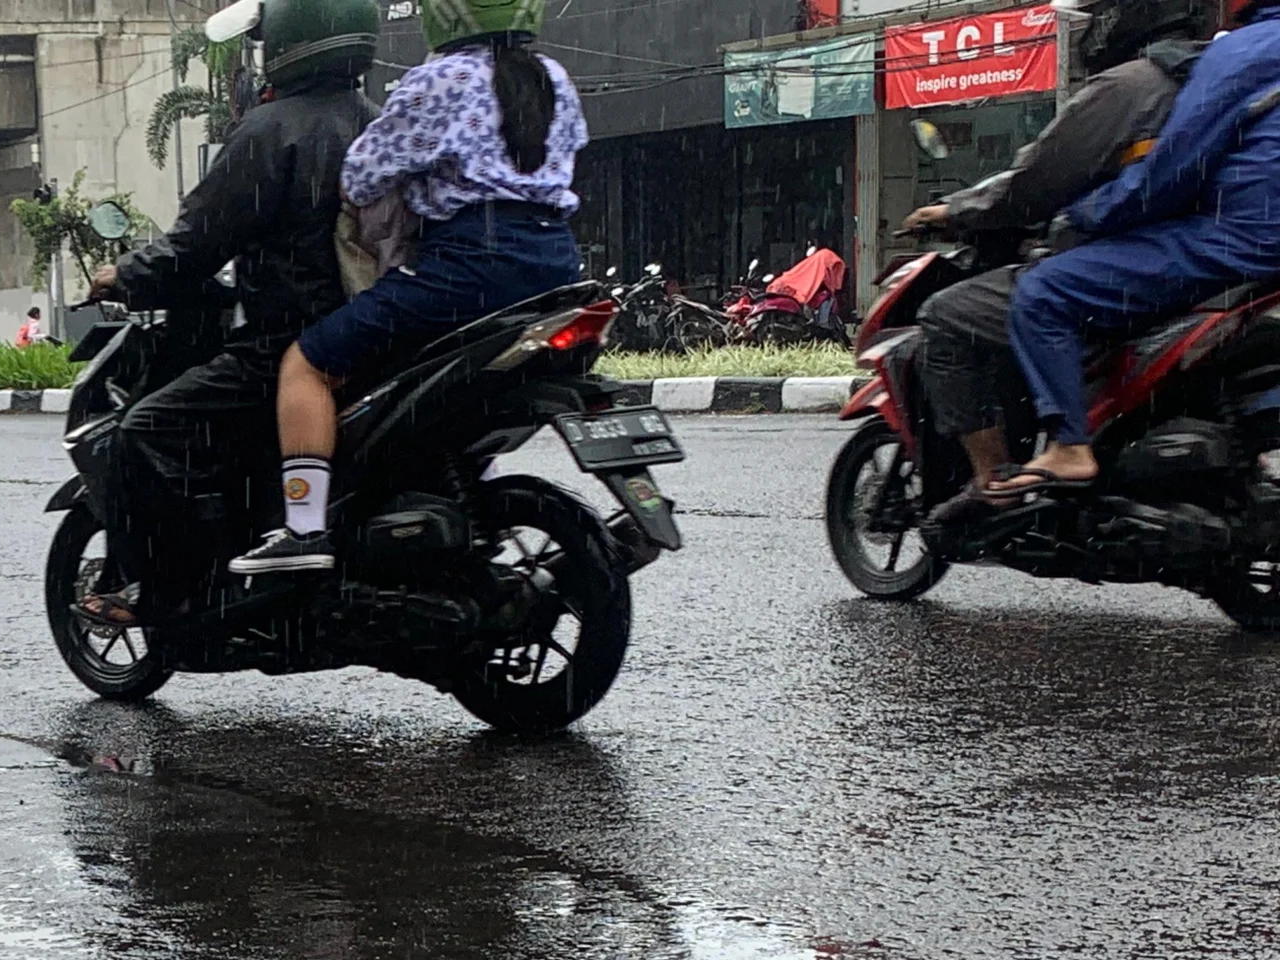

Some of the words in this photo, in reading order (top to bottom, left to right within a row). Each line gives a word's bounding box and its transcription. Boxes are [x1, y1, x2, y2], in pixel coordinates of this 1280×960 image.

[388, 1, 413, 20] AND
[922, 22, 1015, 65] TCL
[916, 74, 957, 94] inspire
[959, 68, 1023, 91] greatness
